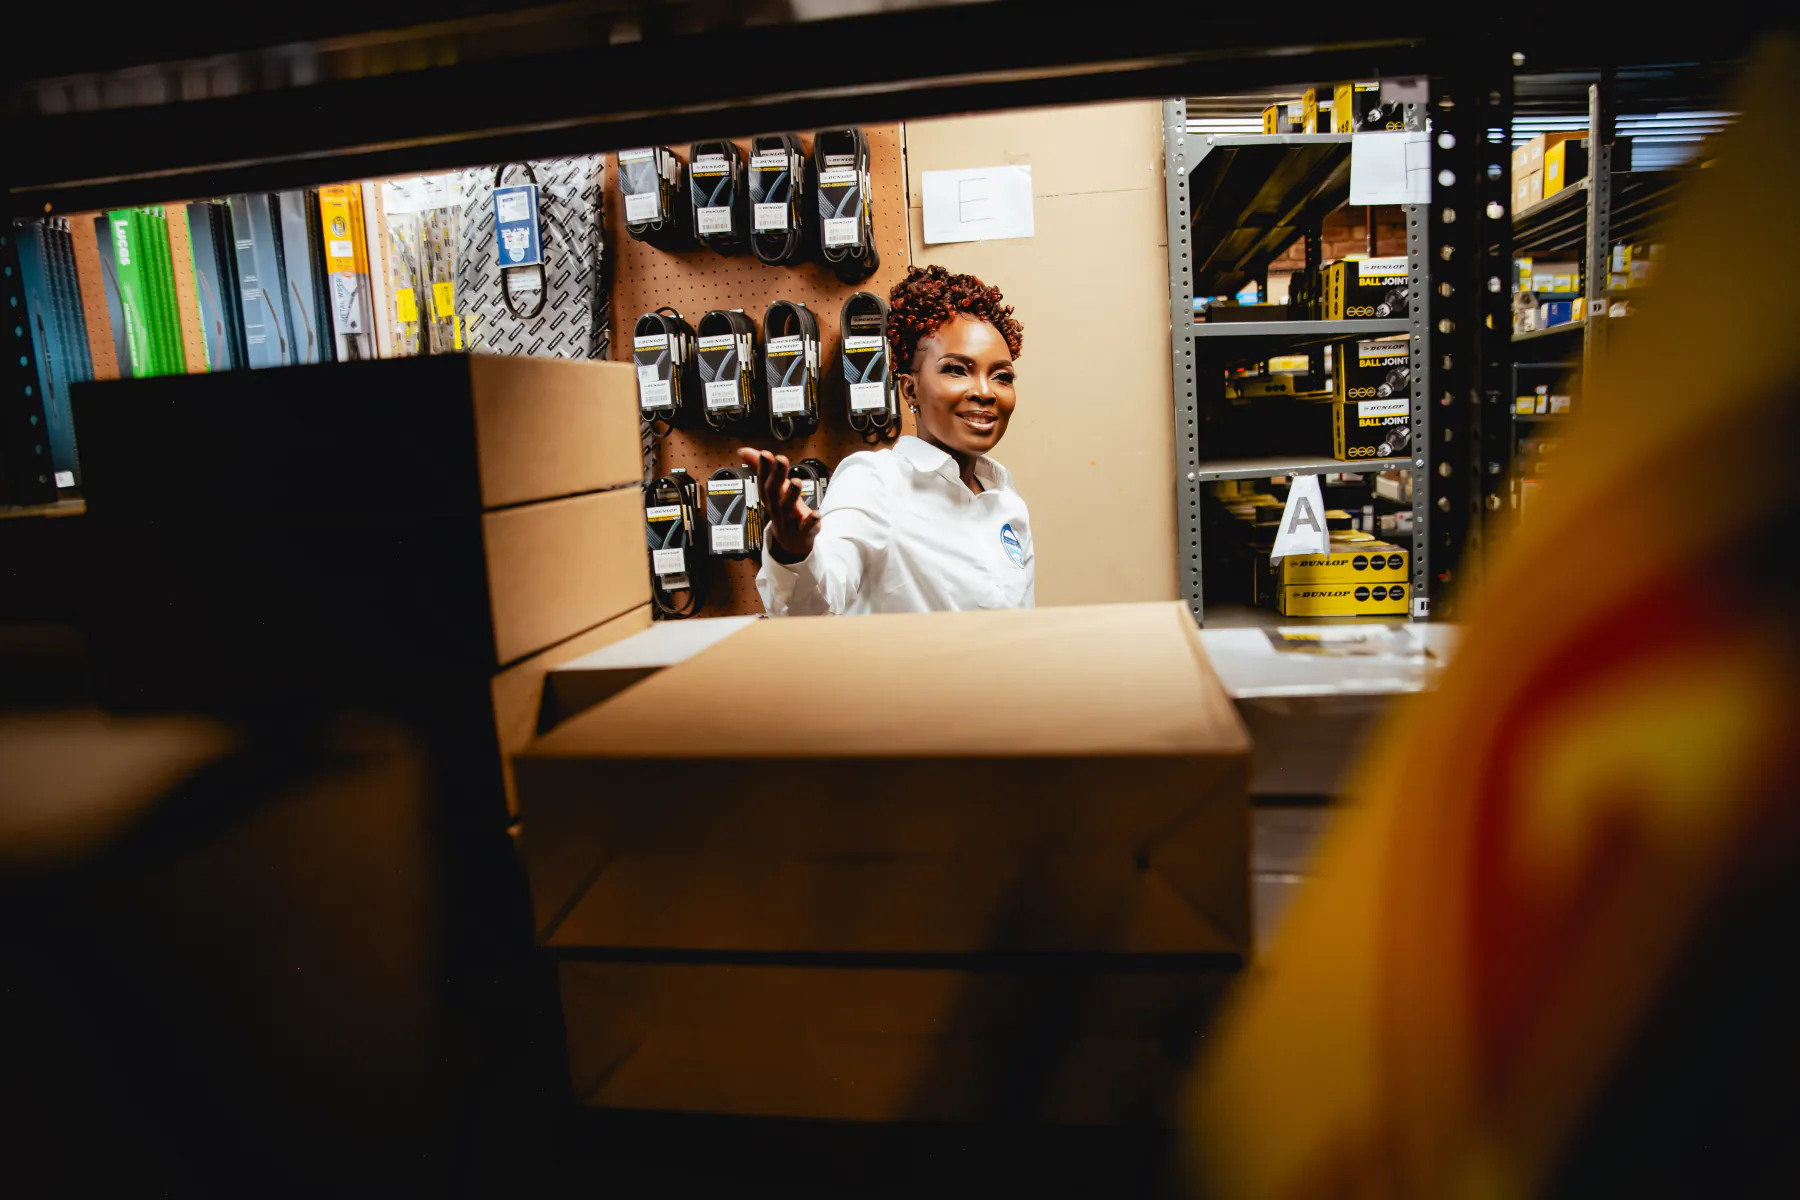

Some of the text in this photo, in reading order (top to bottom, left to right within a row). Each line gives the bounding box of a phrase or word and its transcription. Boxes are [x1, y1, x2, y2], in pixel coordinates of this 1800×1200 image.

[958, 177, 995, 224] E
[1359, 277, 1408, 286] BALL JOINT
[1359, 357, 1409, 367] BALL JOINT
[1359, 416, 1409, 427] BALL JOINT
[1287, 496, 1322, 534] A
